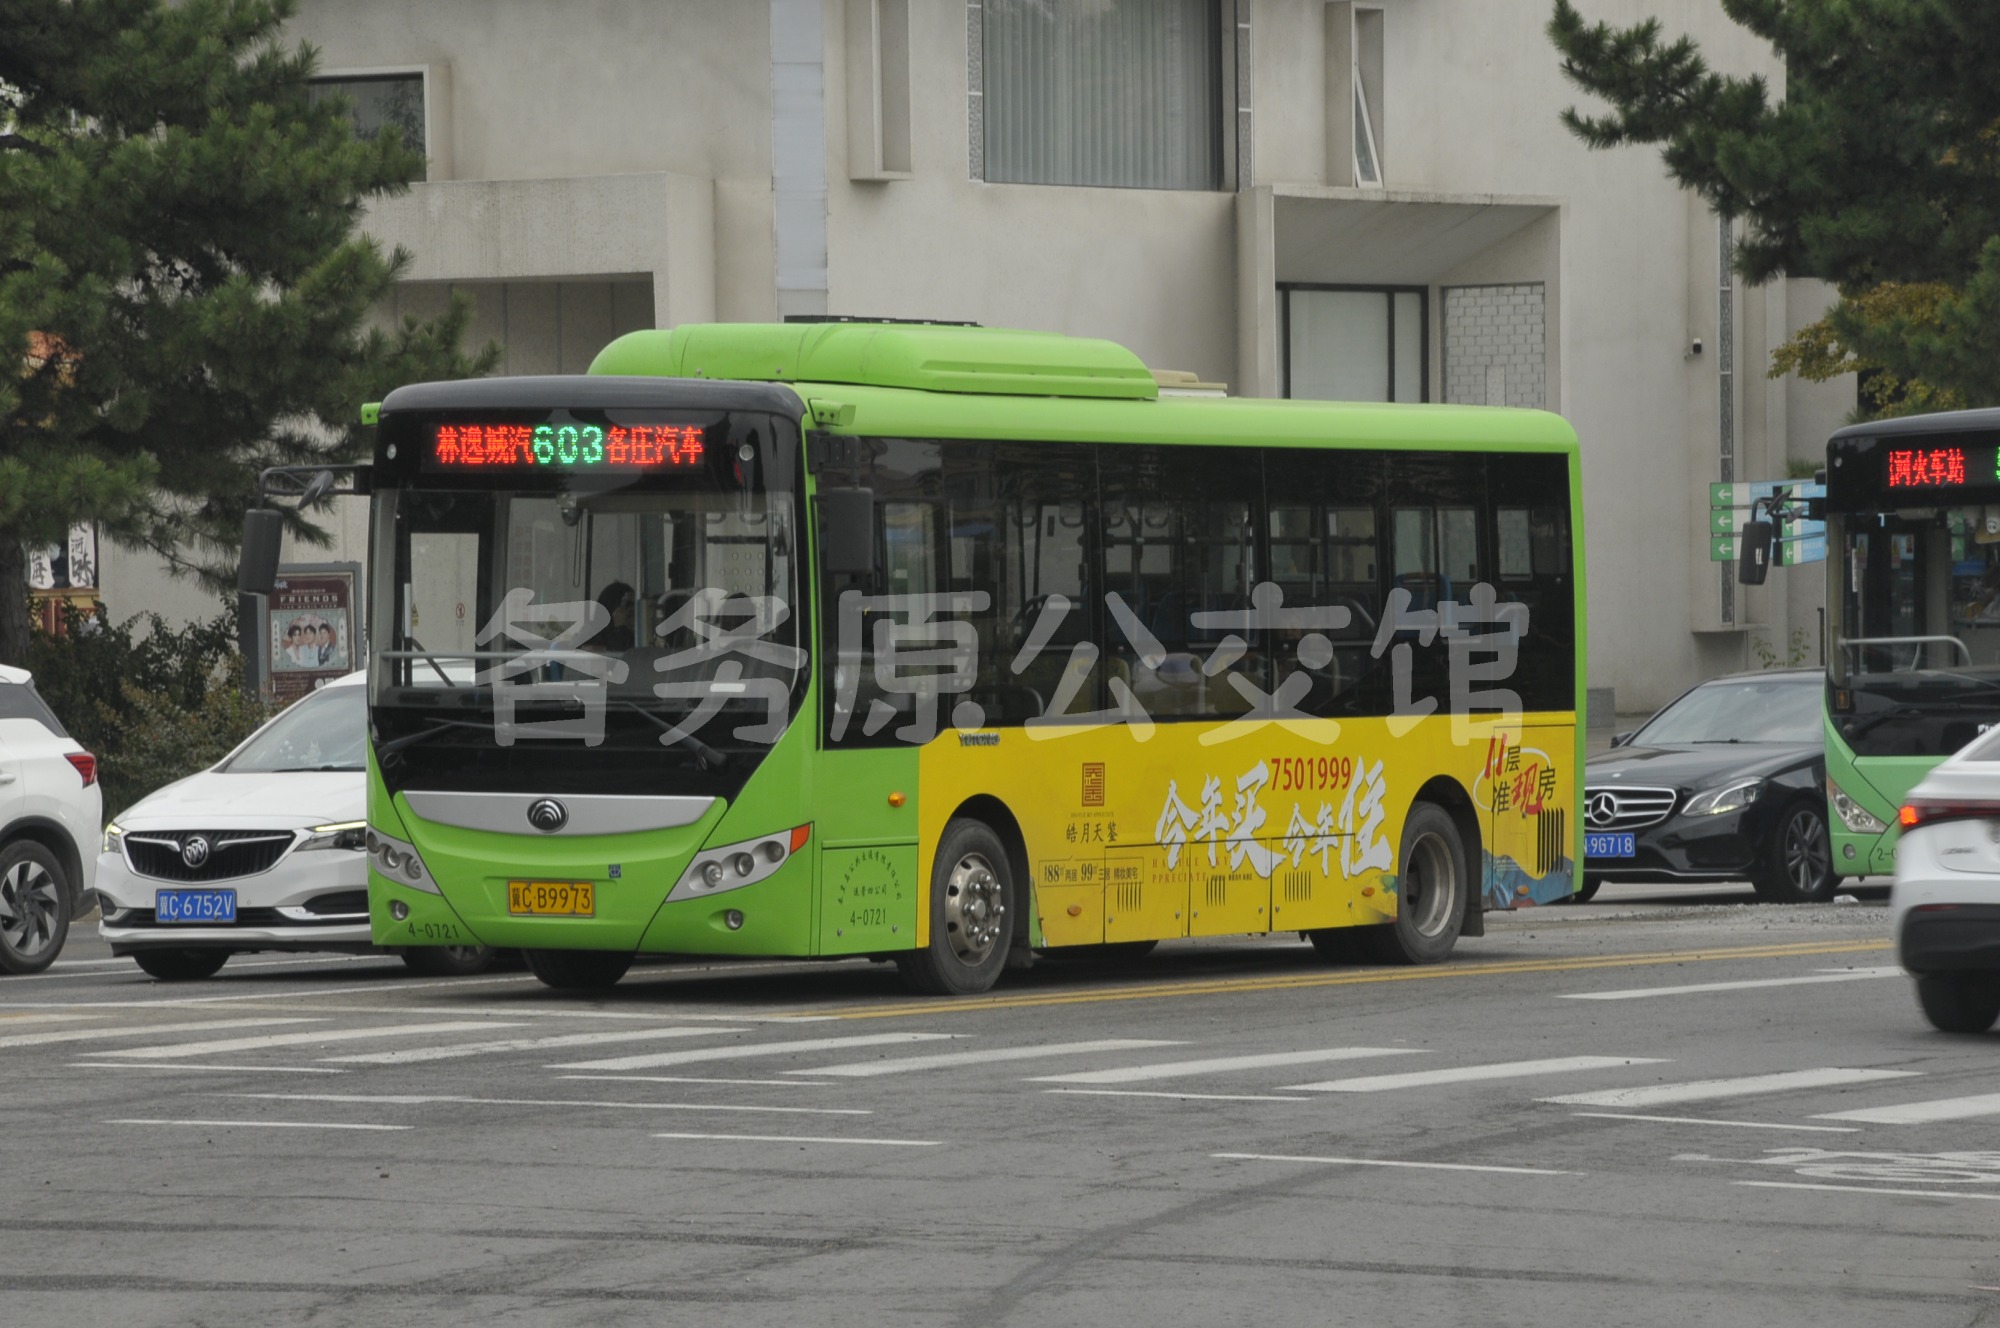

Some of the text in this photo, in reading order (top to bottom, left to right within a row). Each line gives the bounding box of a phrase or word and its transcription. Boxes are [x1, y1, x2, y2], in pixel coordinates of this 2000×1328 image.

[533, 426, 603, 463] 603
[605, 426, 703, 463] 各庄汽车
[280, 595, 338, 603] FRIENDS
[1271, 757, 1351, 791] 7501999
[1491, 763, 1557, 816] 准现房
[1066, 820, 1118, 844] 皓月天鉴
[1155, 760, 1287, 879] 今年买
[1283, 755, 1393, 880] 今年住
[408, 922, 459, 939] 4-0721
[850, 908, 886, 926] 4-0721
